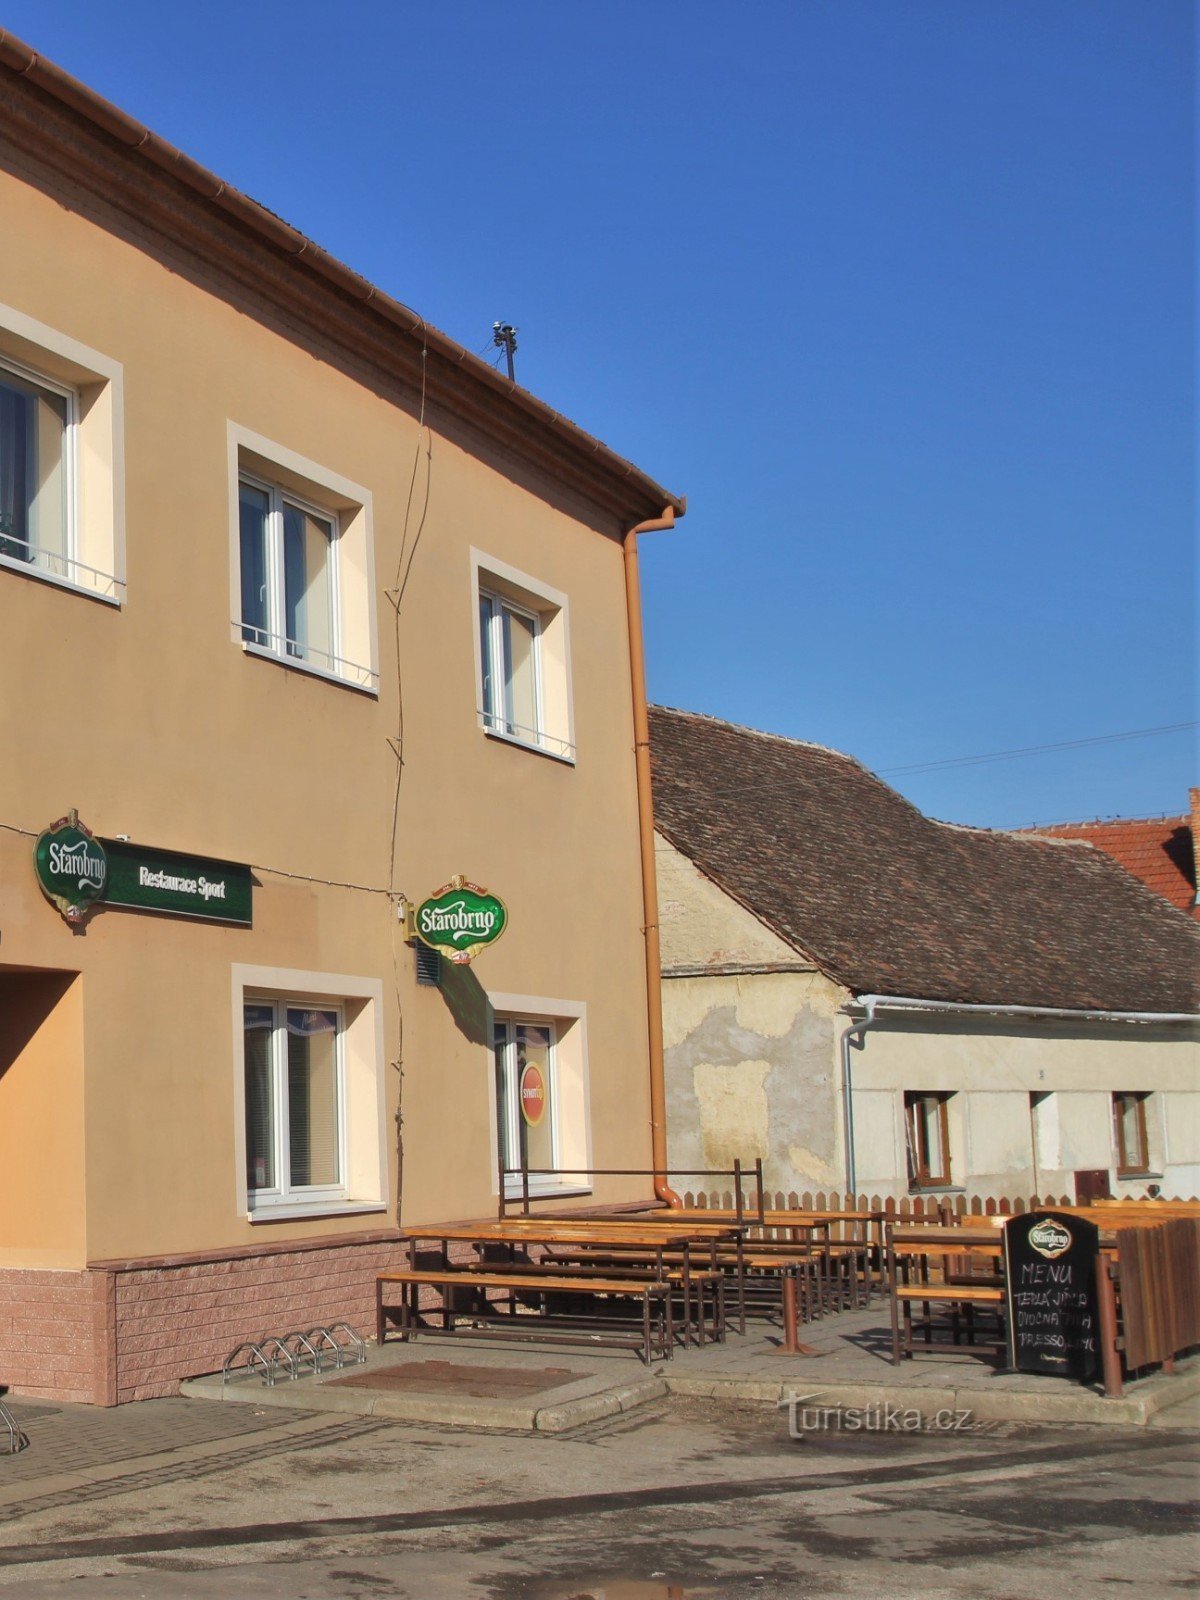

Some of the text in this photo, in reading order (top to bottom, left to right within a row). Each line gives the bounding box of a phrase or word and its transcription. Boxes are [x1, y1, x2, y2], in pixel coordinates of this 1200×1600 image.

[49, 840, 106, 890] Starobrno
[139, 866, 226, 900] Restaurace Sport
[421, 900, 495, 941] Starobrno
[1032, 1229, 1068, 1248] Starobrno
[1021, 1262, 1072, 1284] MENU
